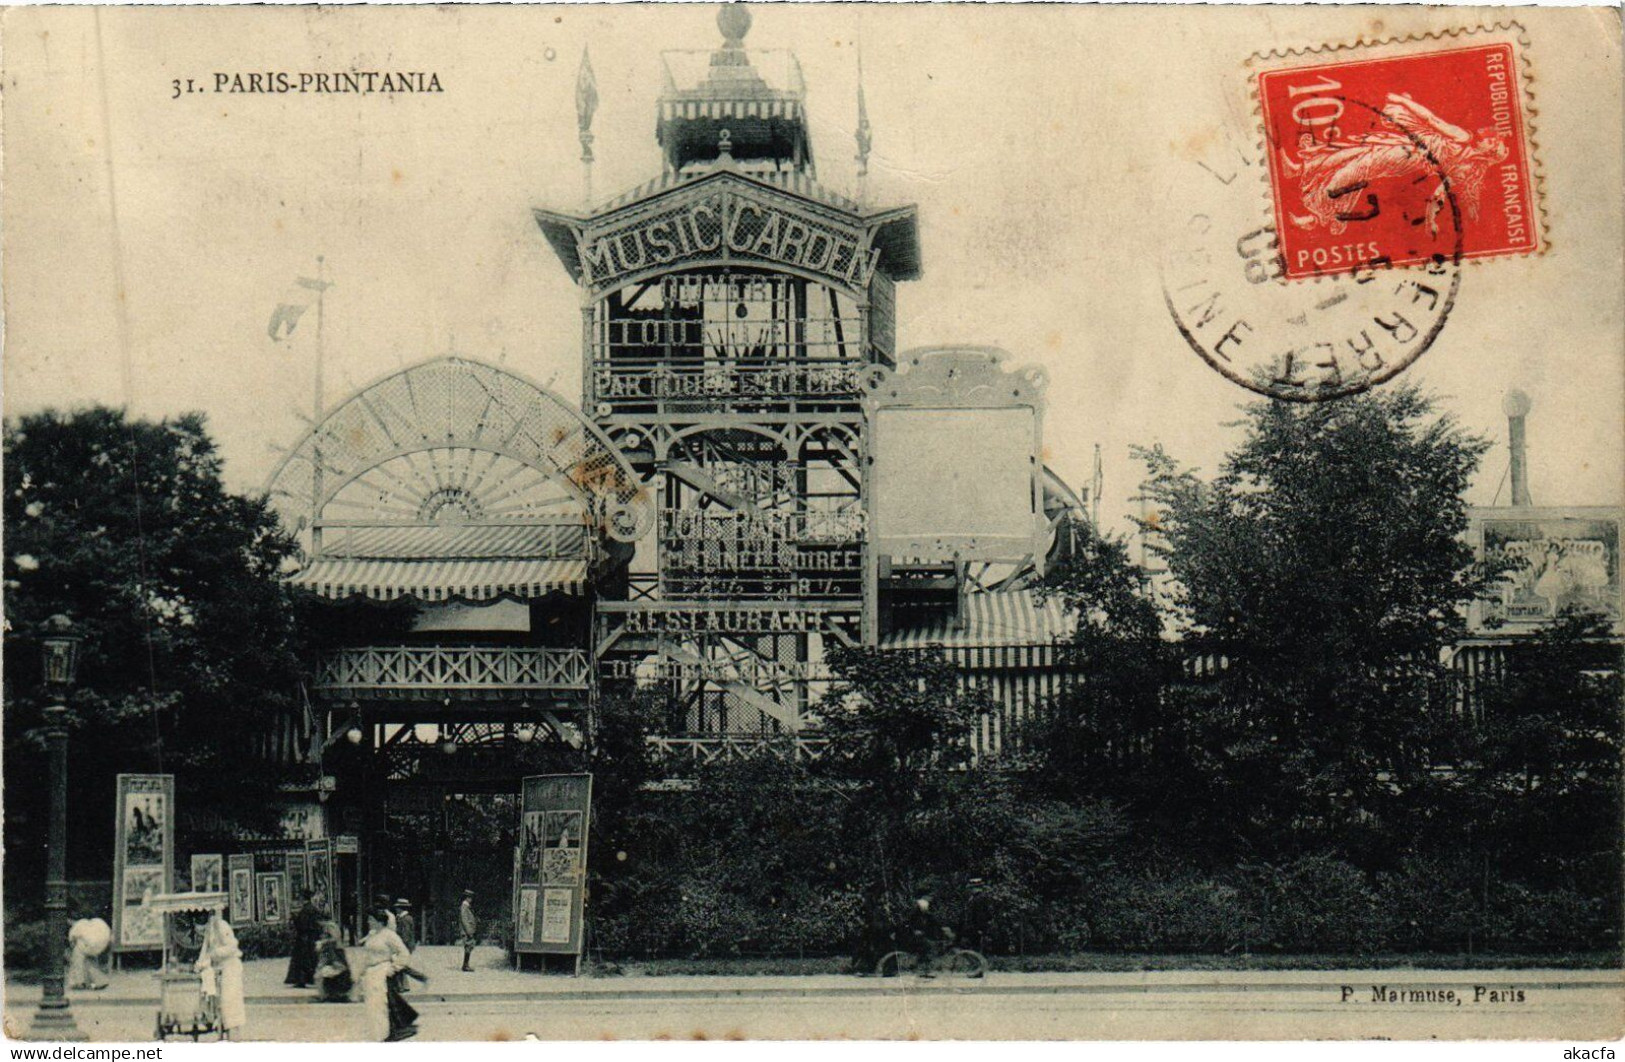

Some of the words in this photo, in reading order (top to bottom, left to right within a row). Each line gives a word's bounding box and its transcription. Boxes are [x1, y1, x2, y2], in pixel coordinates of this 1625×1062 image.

[1500, 164, 1527, 246] FRANÇAISE
[576, 204, 721, 285] MUSIC
[1297, 241, 1381, 269] POSTES
[660, 274, 794, 302] OUVERT
[595, 370, 643, 397] PAR
[626, 609, 828, 633] RESTAURANT
